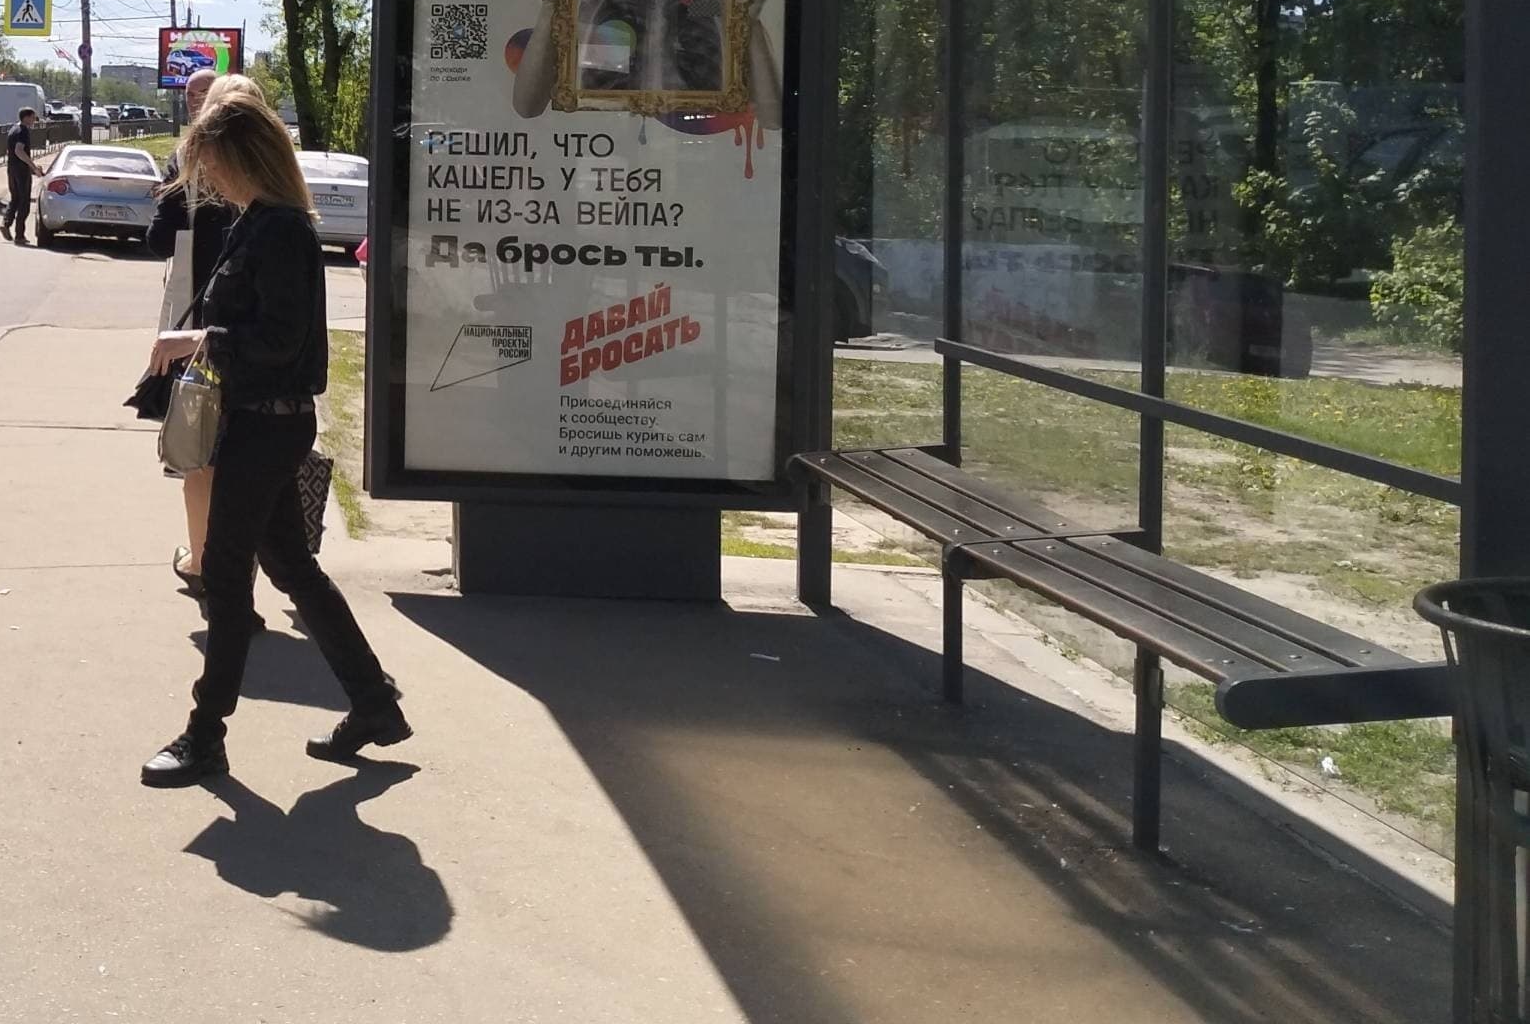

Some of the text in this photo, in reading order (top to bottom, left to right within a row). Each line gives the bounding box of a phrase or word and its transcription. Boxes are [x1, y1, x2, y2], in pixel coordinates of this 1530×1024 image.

[427, 130, 615, 160] РЕШИЛ, ЧТО
[427, 165, 546, 191] КАШЕЛЬ
[560, 167, 577, 192] У
[427, 196, 685, 227] НЕ ИЗ-ЗА ВЕЙПА?
[425, 234, 705, 273] Да брось ты.
[560, 282, 671, 356] ДАВАЙ
[463, 327, 530, 338] НАЦИОНАЛЬНЫЕ
[492, 337, 530, 348] ПРОЕКТЫ
[560, 314, 702, 387] БРОСАТЬ
[498, 348, 529, 358] РОССИИ
[559, 395, 673, 411] Присоединяйся
[559, 412, 660, 428] к сообществу.
[559, 426, 705, 444] Бросишь курить сам
[558, 445, 706, 458] и другим поможешь.
